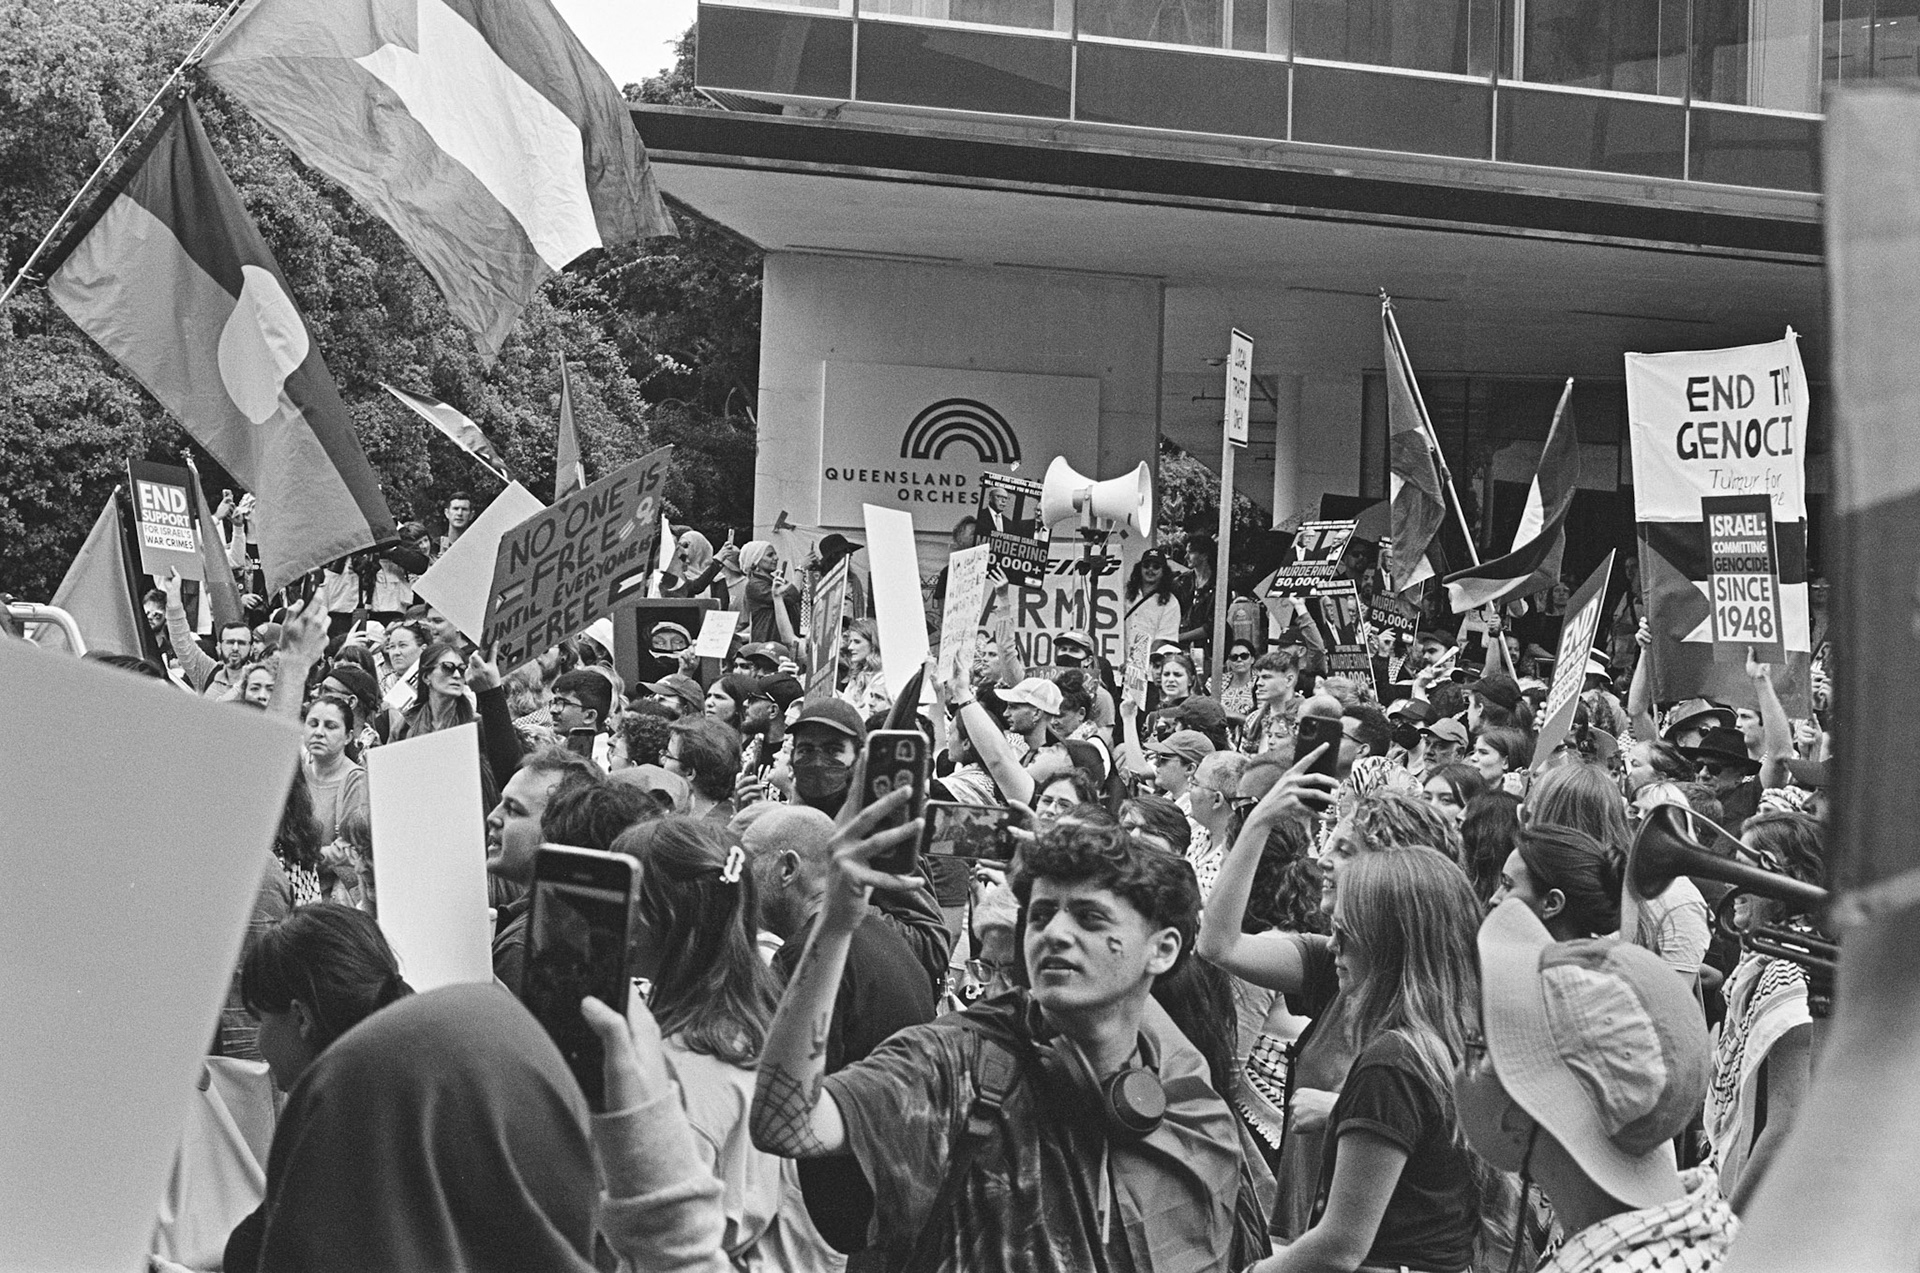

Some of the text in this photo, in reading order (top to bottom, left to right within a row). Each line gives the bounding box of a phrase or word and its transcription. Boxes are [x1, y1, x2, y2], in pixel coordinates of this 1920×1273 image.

[1686, 374, 1755, 412] END
[1676, 415, 1793, 461] GENOCI
[825, 467, 967, 488] QUEENSLAND
[1765, 467, 1782, 494] for
[140, 483, 187, 513] END
[897, 488, 979, 504] ORCHES
[142, 510, 190, 528] SUPPORT
[510, 461, 660, 575] NO ONE IS
[1709, 514, 1767, 537] ISRAEL:
[144, 525, 192, 539] FOR ISRAEL'S
[146, 535, 194, 550] WAR CRIMES
[531, 512, 623, 598] FREE
[1712, 541, 1768, 554] COMMITTING
[987, 552, 1042, 575] 0,000+
[1276, 565, 1335, 577] MURDERING
[1714, 557, 1769, 572] GENOCIDE
[481, 601, 543, 653] UNTIL
[552, 540, 639, 608] EVERYONE
[1716, 576, 1771, 602] SINCE
[525, 585, 600, 659] FREE
[1371, 609, 1414, 631] 50,000+
[1557, 597, 1600, 667] END
[1718, 605, 1774, 639] 1948
